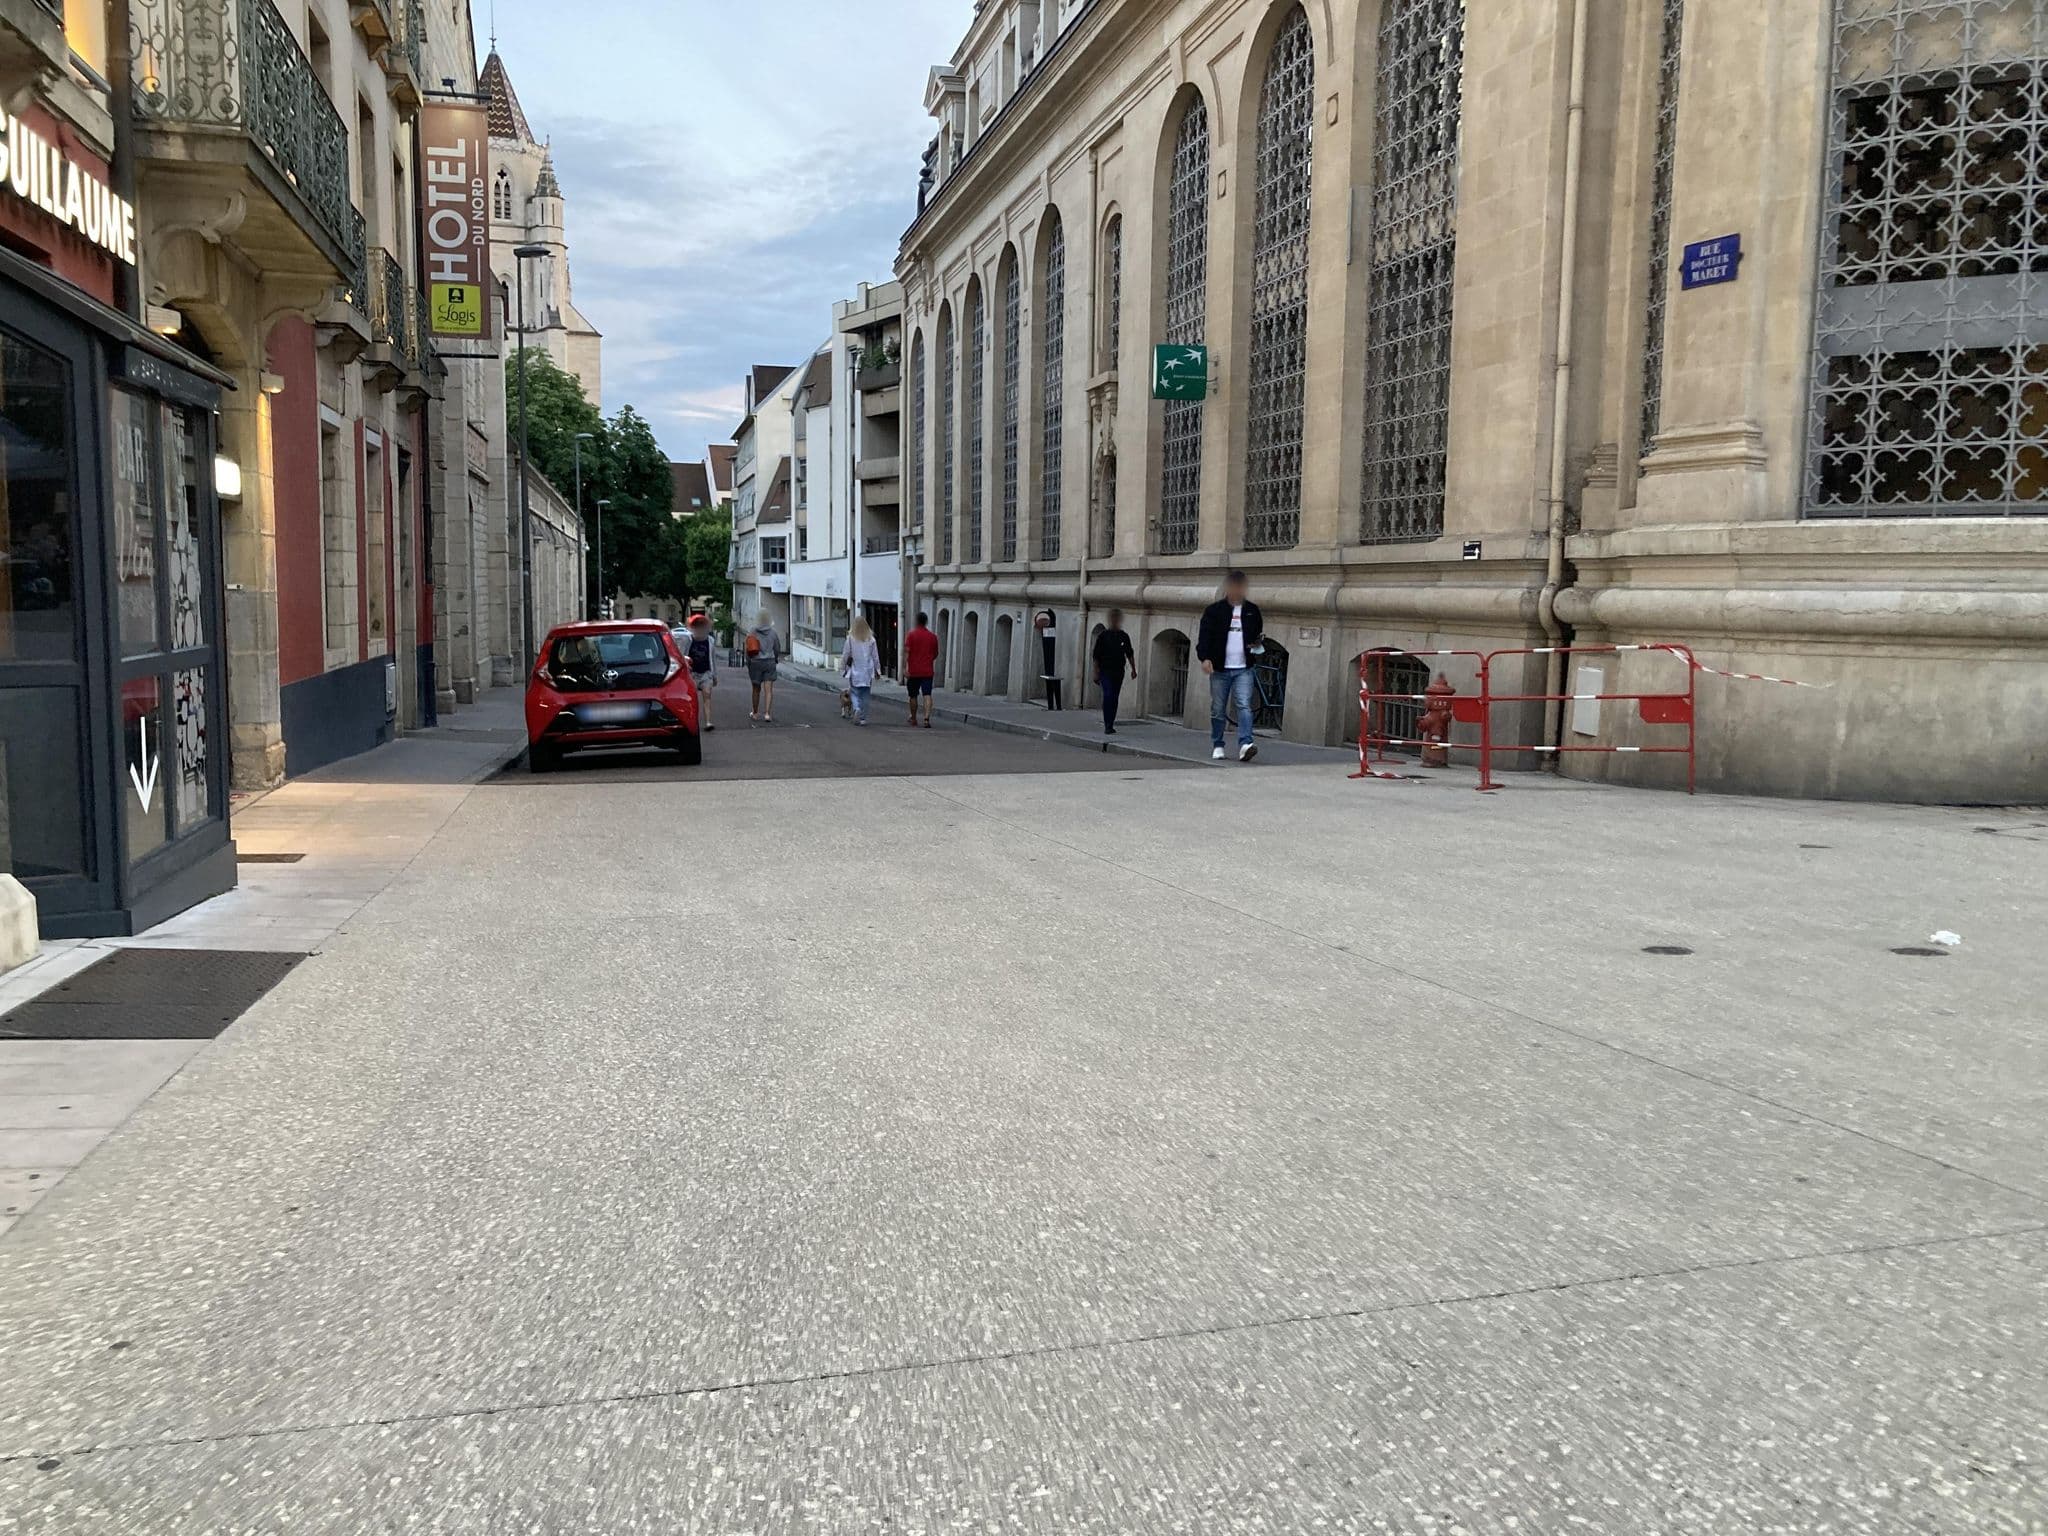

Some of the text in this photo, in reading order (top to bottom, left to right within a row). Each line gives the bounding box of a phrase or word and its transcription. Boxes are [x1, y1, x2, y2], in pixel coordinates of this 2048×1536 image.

[427, 139, 468, 281] HOTEL
[471, 177, 485, 245] DU NORD
[1700, 243, 1721, 257] RUE
[1691, 265, 1728, 282] MARET
[437, 304, 476, 326] Logis
[117, 423, 144, 482] BAR
